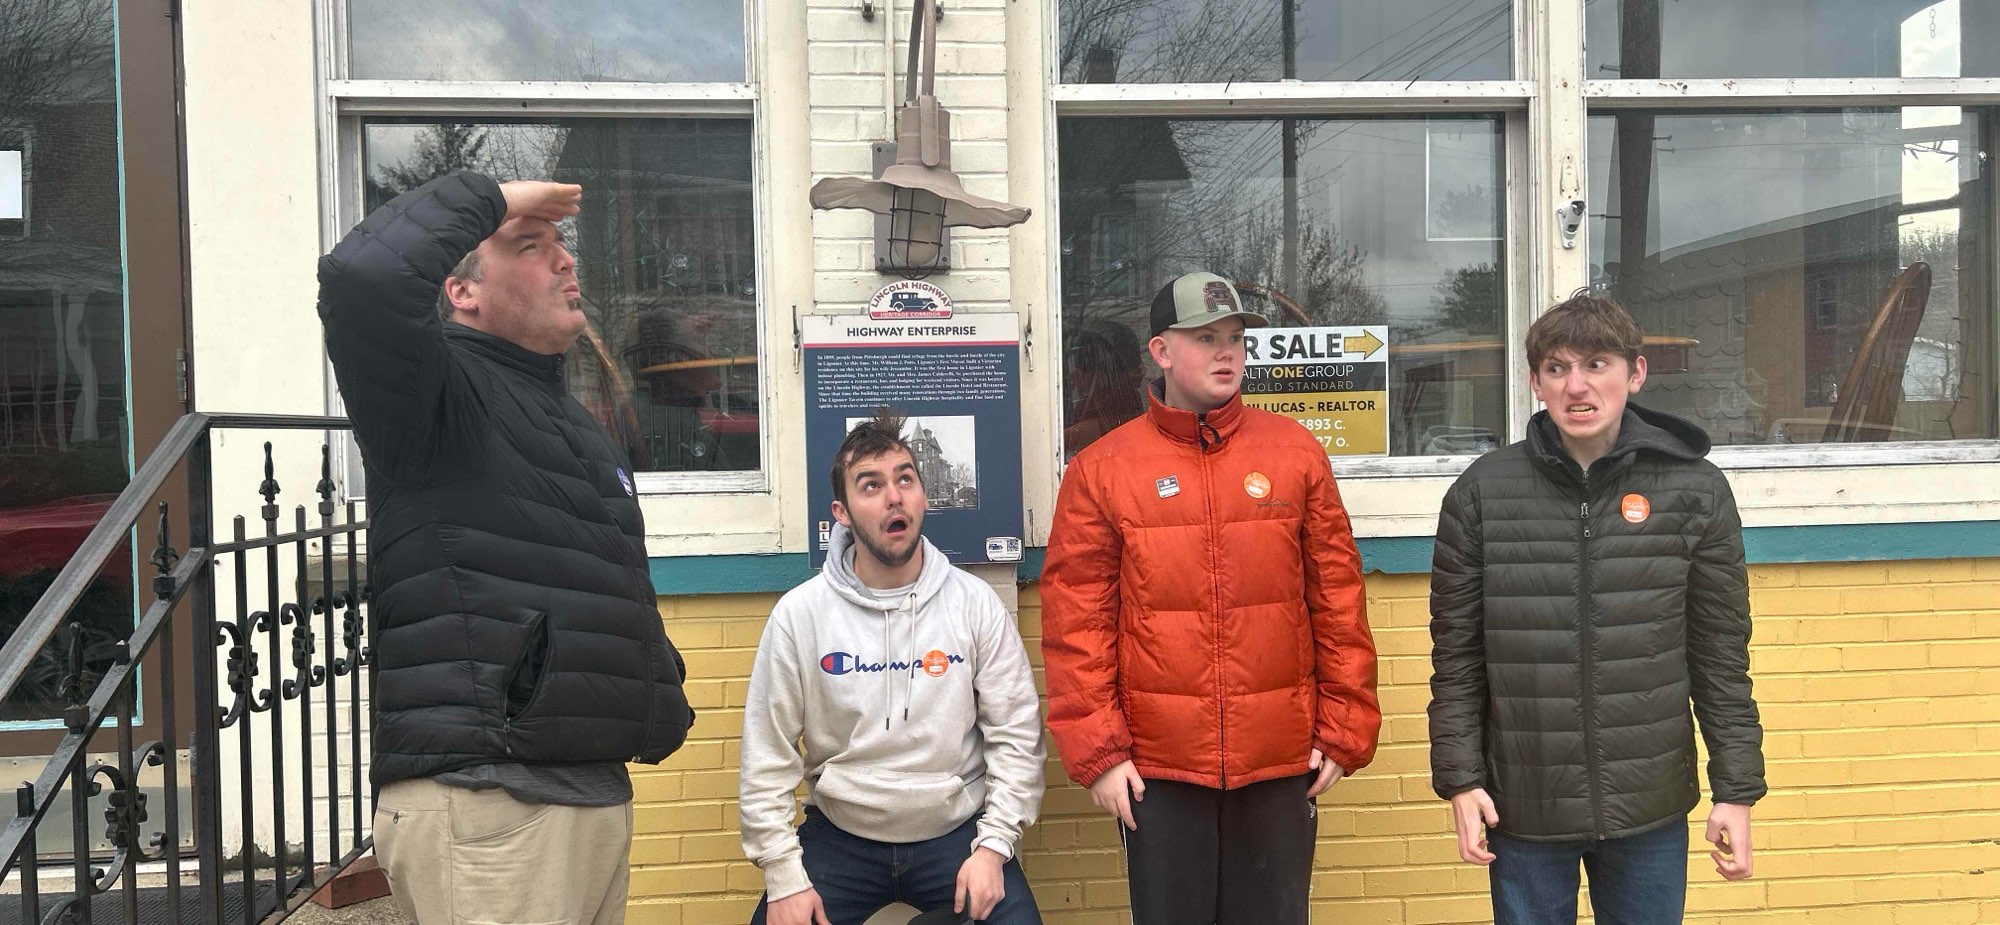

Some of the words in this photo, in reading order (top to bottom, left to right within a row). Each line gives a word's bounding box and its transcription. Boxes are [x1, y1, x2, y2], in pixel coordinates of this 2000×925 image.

[871, 282, 909, 308] LINCOLN
[911, 282, 952, 308] HIGHWAY
[847, 327, 905, 337] HIGHWAY
[907, 325, 977, 336] ENTERPRISE
[1269, 333, 1343, 360] SALE
[1247, 383, 1283, 392] GOLD
[1288, 380, 1354, 391] STANDARD
[1263, 402, 1305, 413] LUCAS
[1317, 400, 1376, 412] REALTOR
[1333, 419, 1346, 430] C.
[820, 651, 965, 679] Champn
